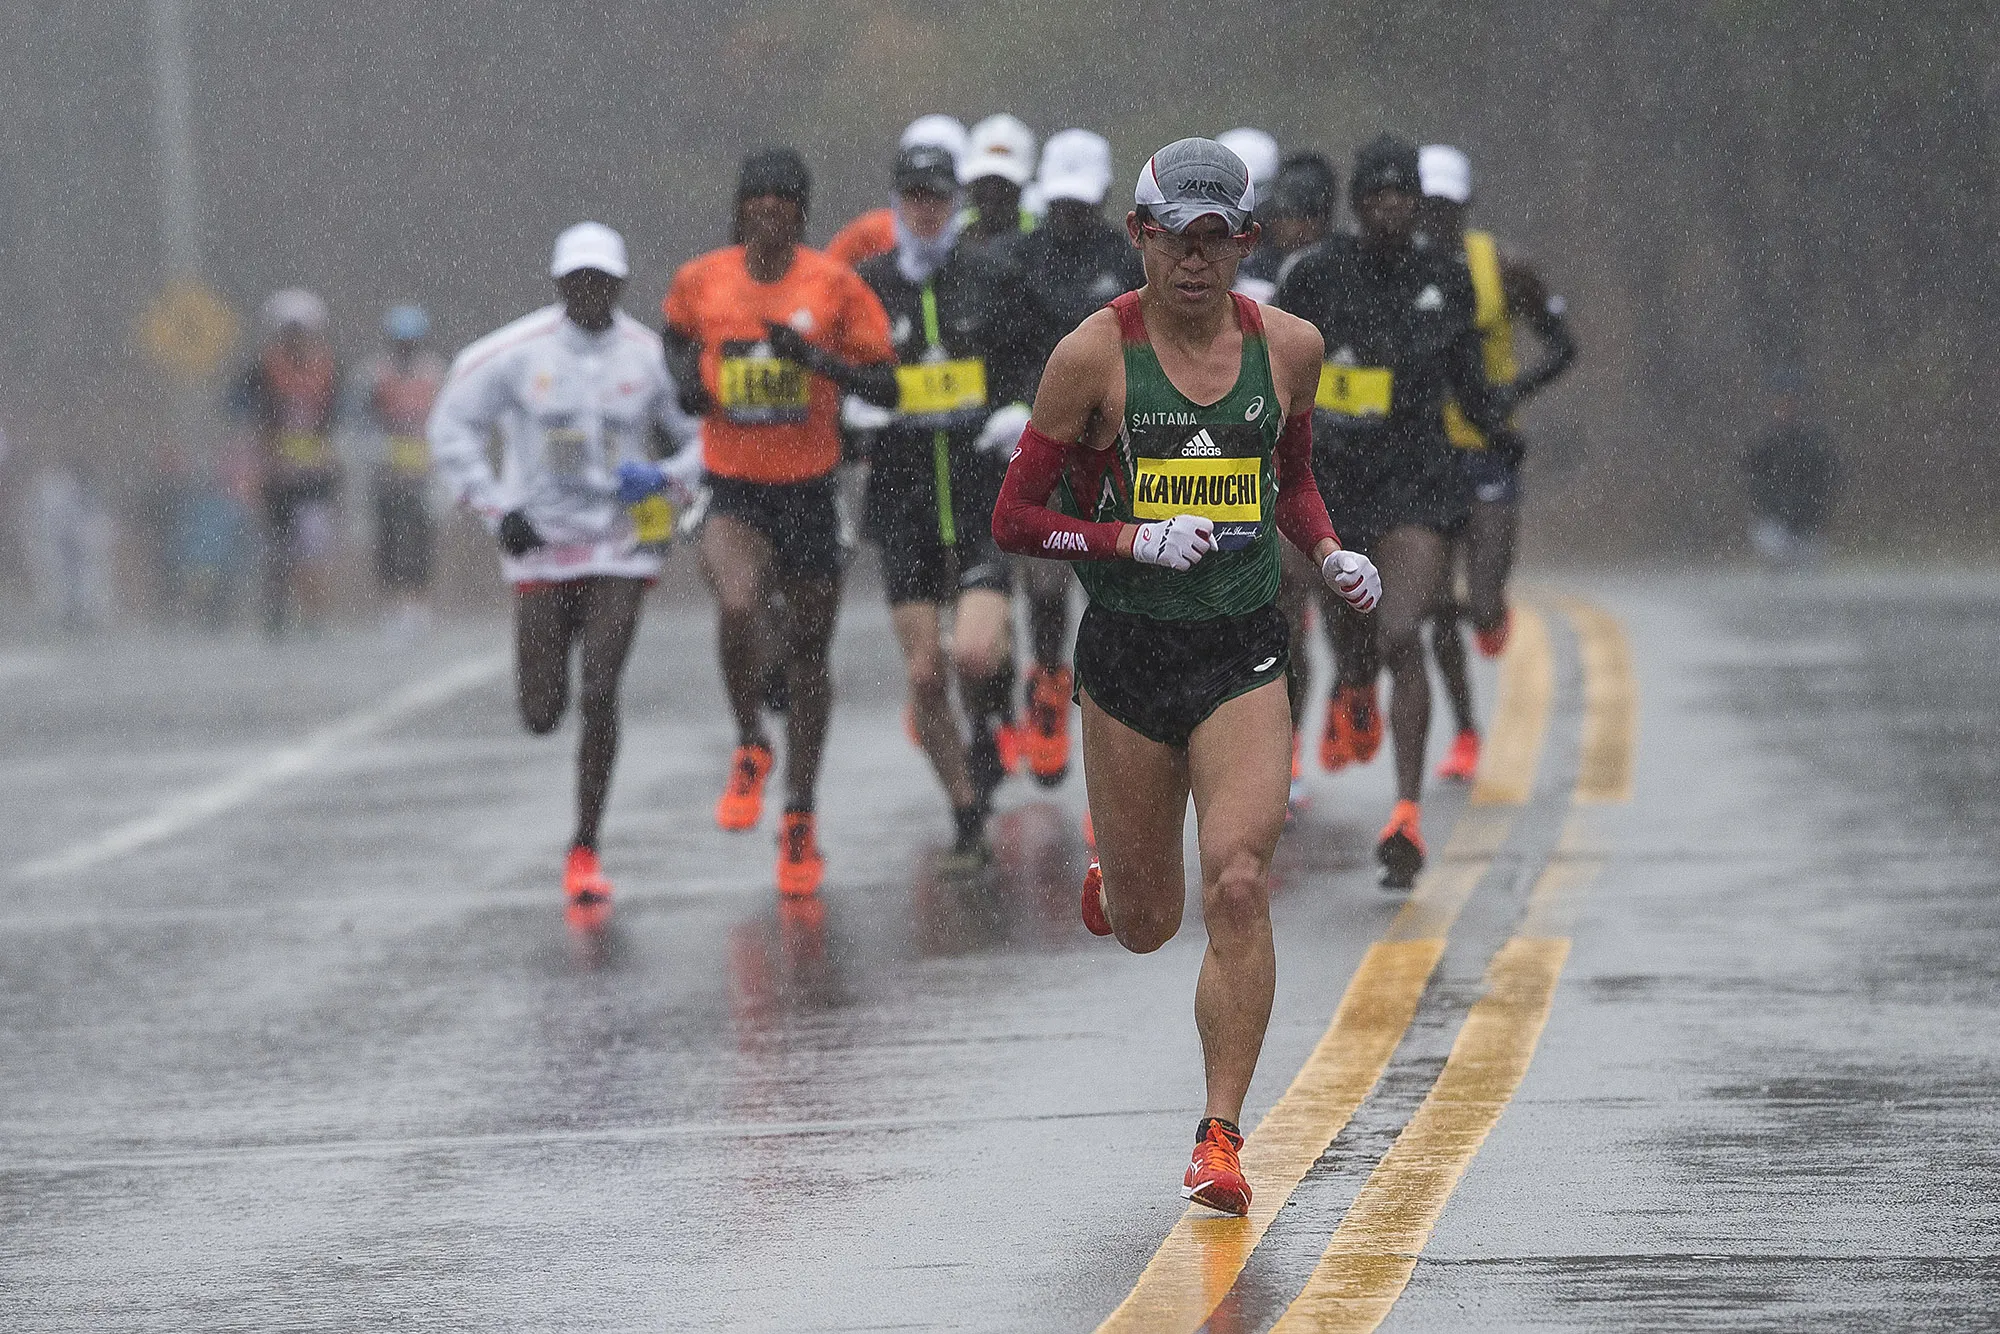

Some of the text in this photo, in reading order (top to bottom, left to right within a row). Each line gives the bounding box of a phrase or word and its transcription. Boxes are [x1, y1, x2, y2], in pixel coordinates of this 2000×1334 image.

[1178, 179, 1229, 194] JAPAN
[1132, 412, 1197, 426] SAITAMA
[1181, 445, 1222, 457] adidas
[1138, 473, 1257, 506] KAWAUCHI
[1042, 530, 1089, 552] JAPAN
